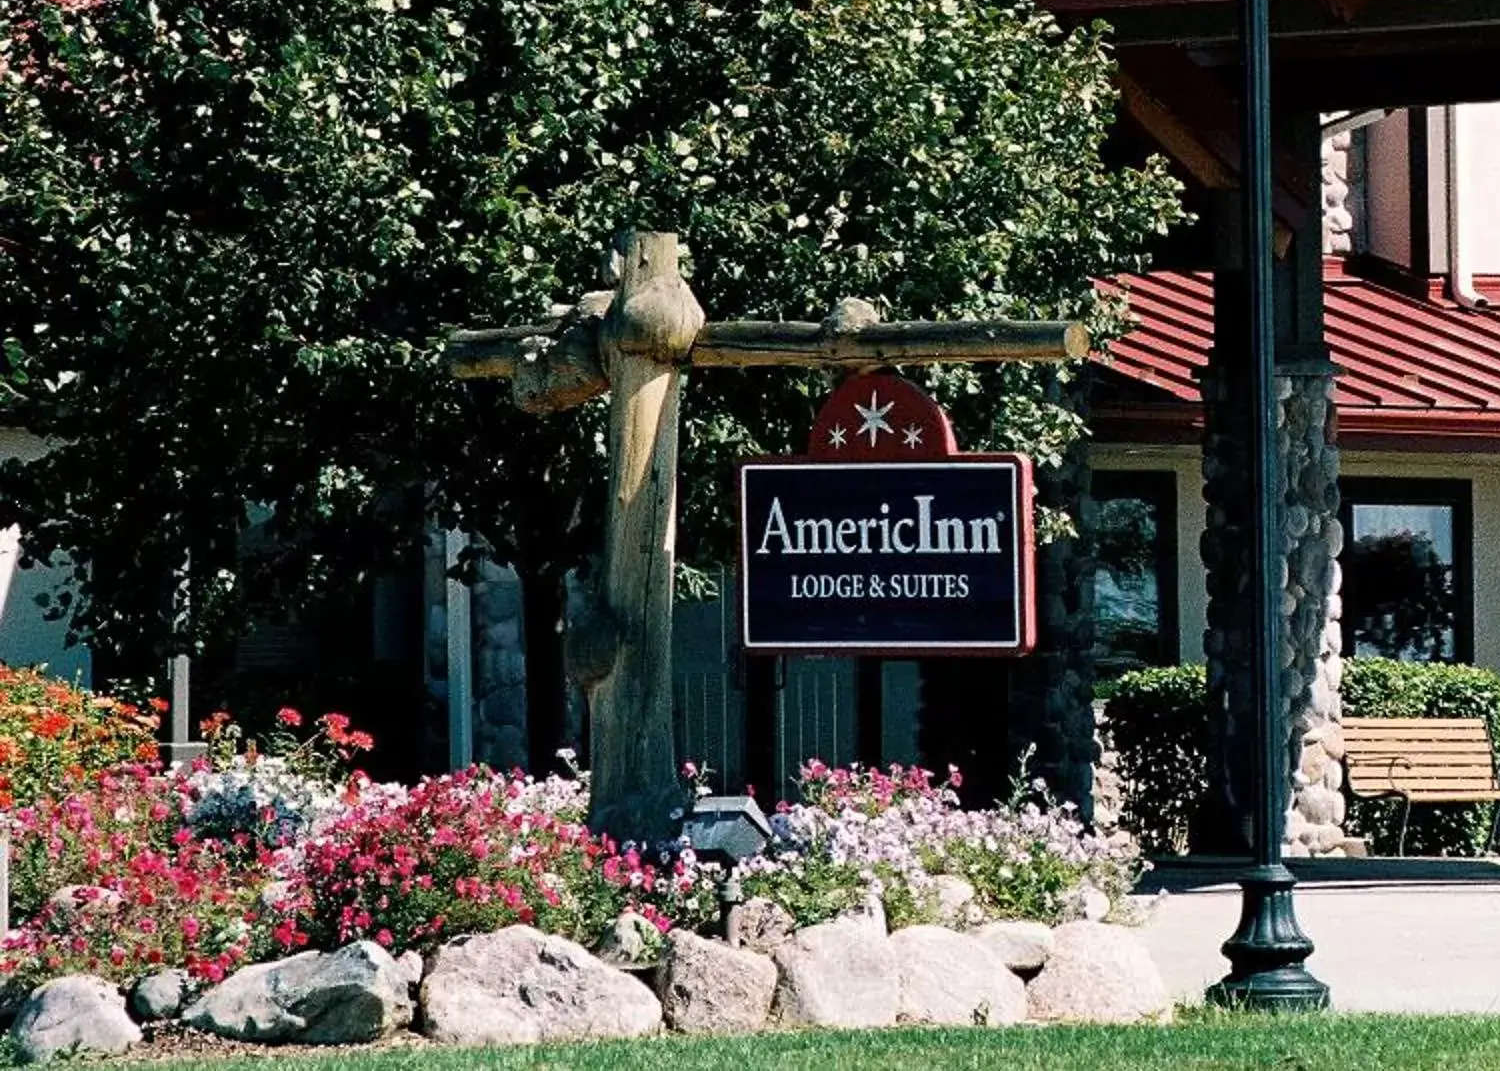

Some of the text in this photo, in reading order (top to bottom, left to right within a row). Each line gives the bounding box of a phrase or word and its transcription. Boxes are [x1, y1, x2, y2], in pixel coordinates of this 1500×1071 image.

[756, 495, 1002, 554] AmericInn
[791, 574, 970, 598] LODGE & SUITES
